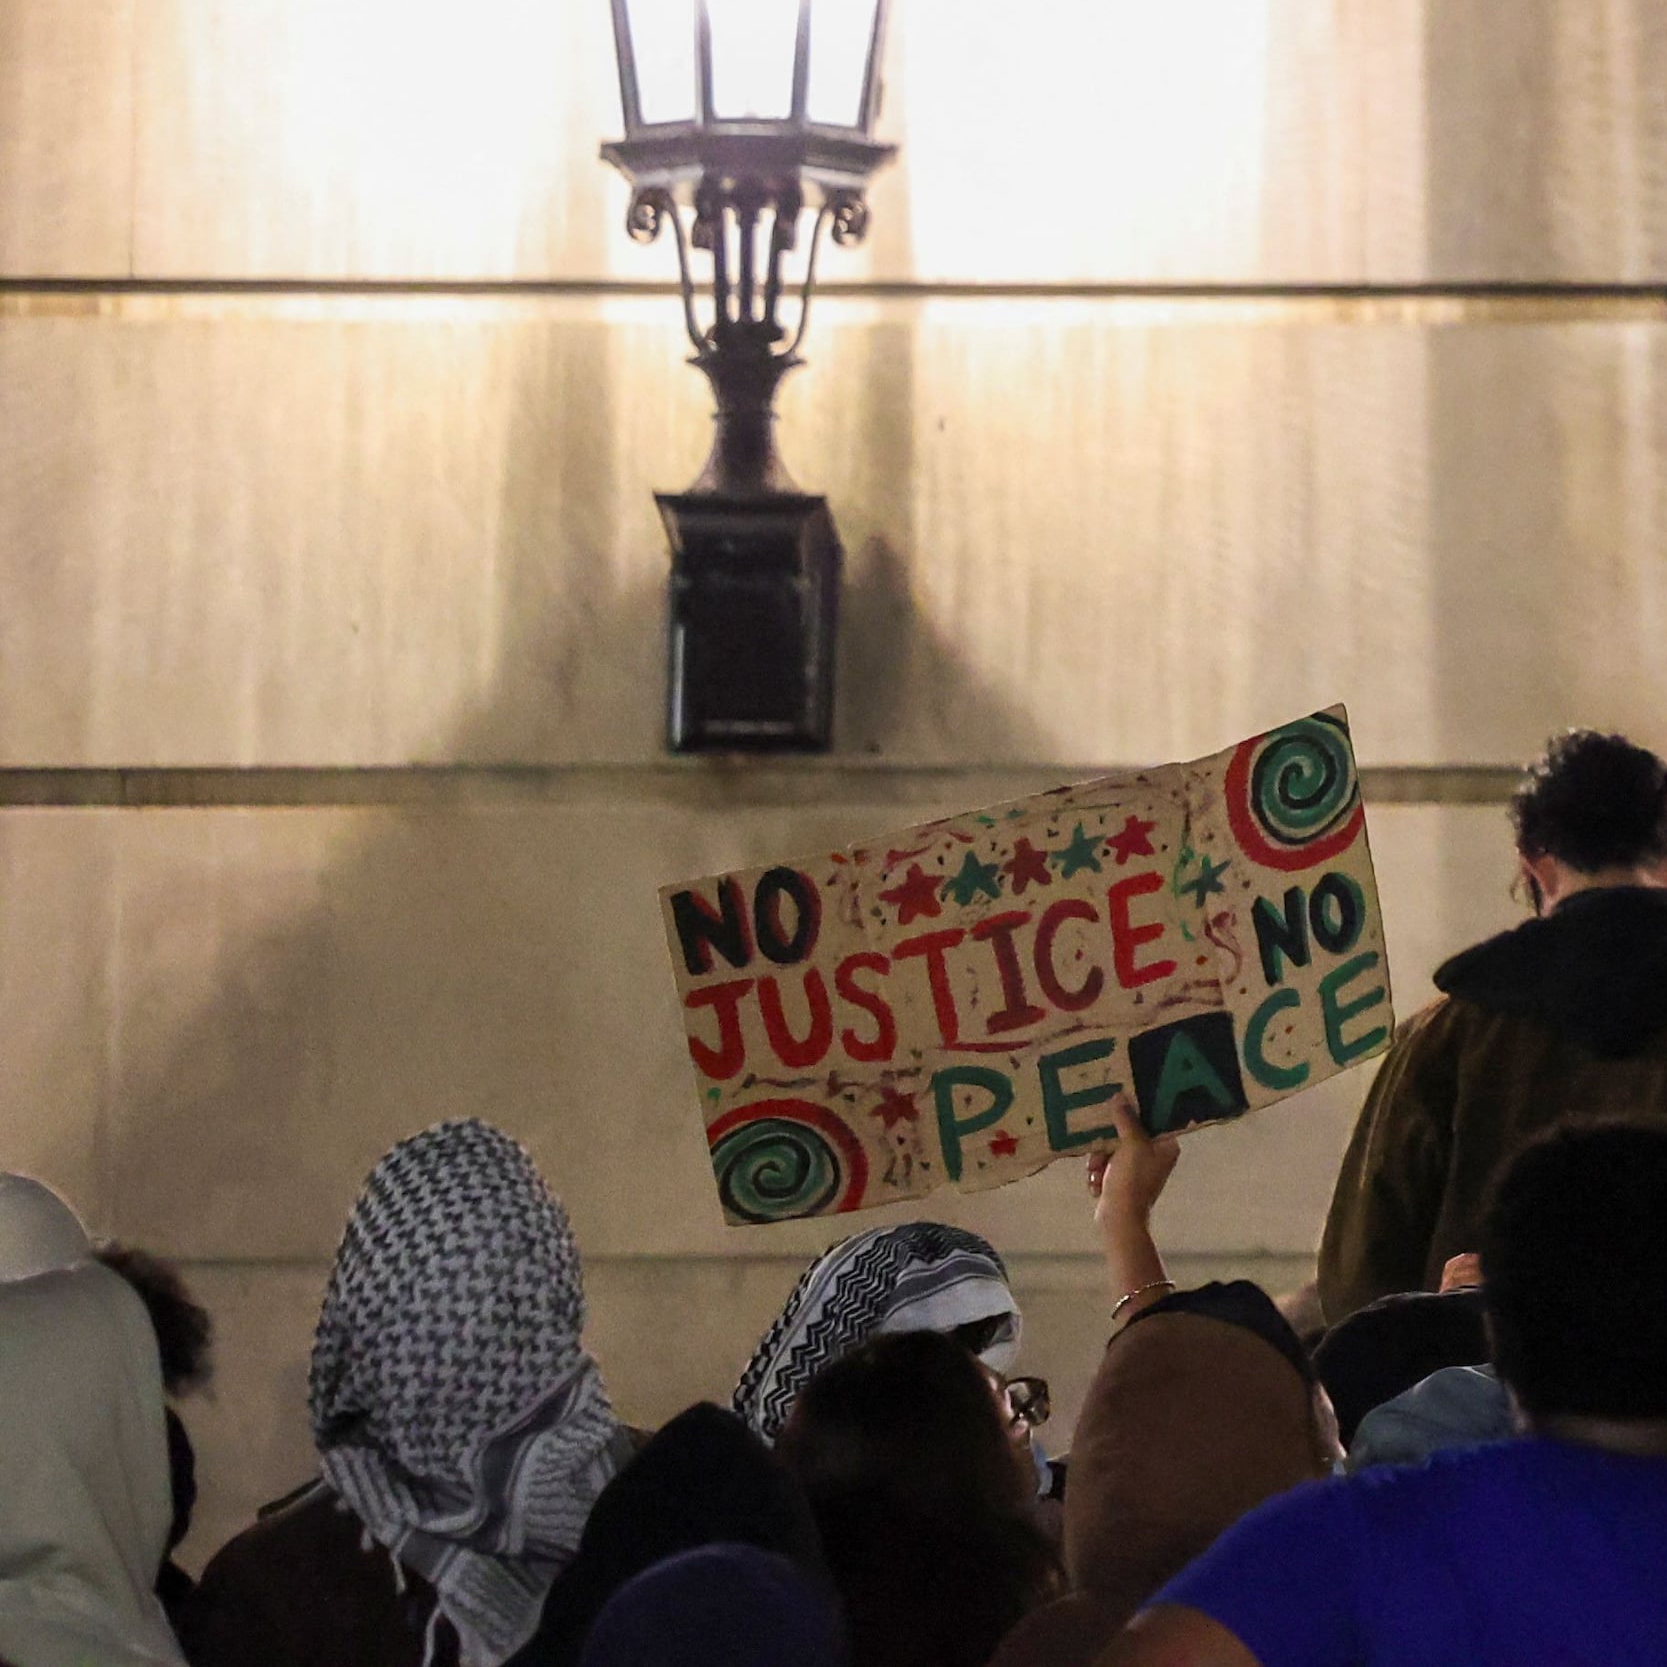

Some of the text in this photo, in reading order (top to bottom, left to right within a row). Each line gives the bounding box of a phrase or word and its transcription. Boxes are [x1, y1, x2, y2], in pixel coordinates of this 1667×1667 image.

[670, 865, 822, 976] NO
[684, 872, 1177, 1081] JUSTICE
[1250, 871, 1365, 985] NO
[930, 950, 1388, 1181] PEACE
